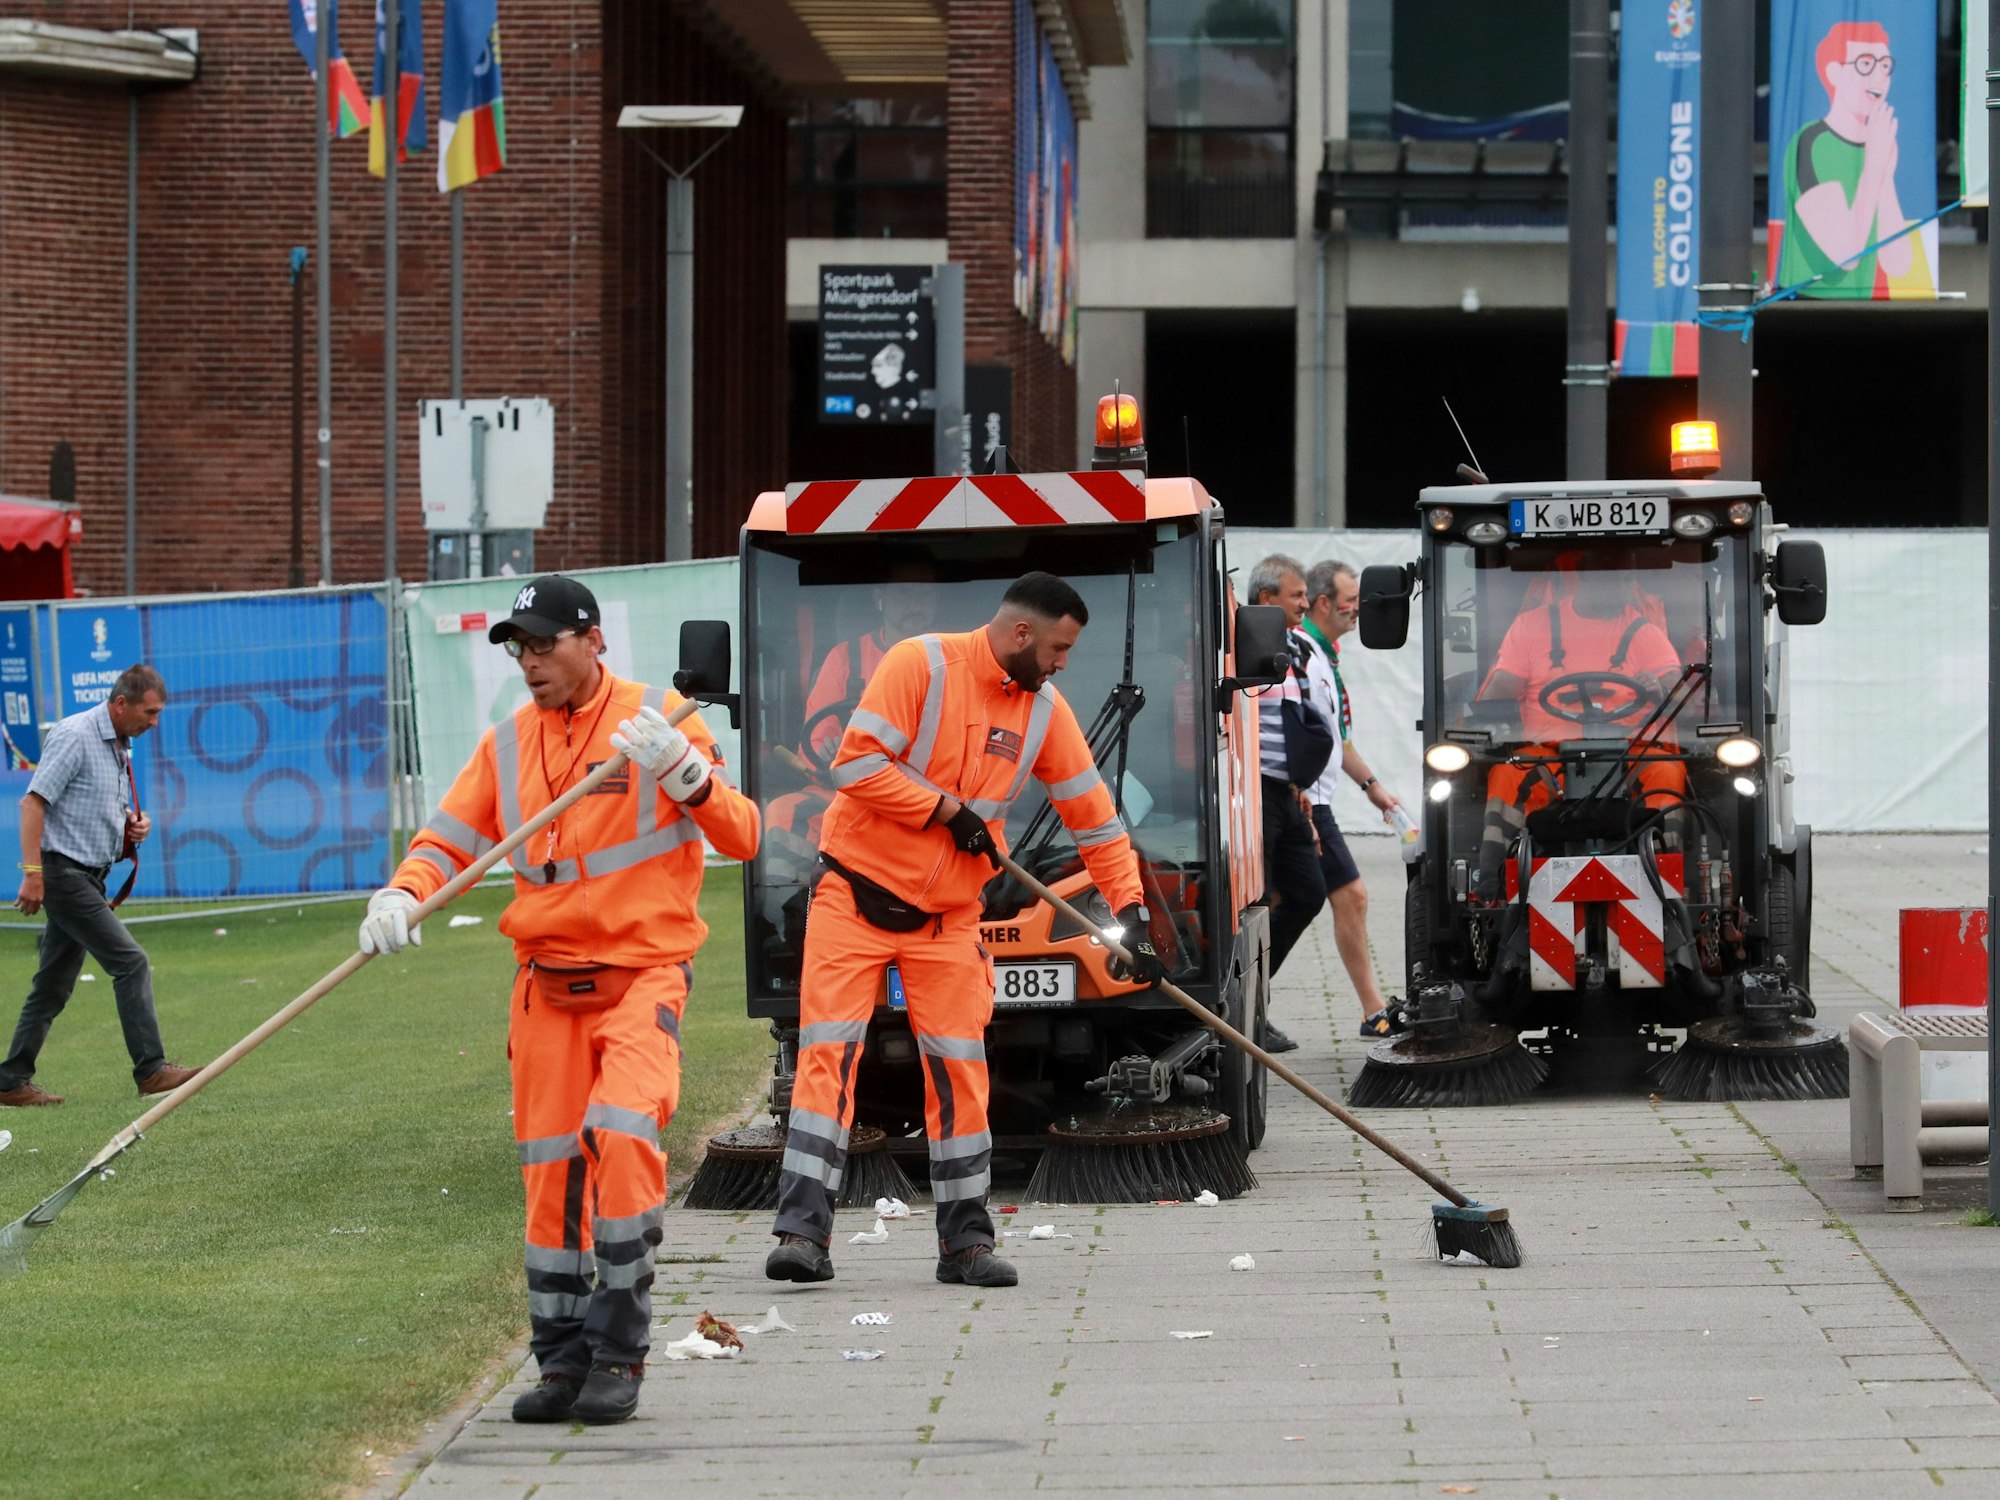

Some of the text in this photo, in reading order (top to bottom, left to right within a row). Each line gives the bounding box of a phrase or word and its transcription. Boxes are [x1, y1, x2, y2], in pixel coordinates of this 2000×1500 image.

[1669, 101, 1693, 287] COLOGNE
[1654, 177, 1667, 289] WELCOME TO
[824, 272, 895, 291] Sportpark
[825, 289, 918, 309] Müngersdorf
[1535, 504, 1551, 527] K
[1570, 503, 1603, 527] WB
[1609, 502, 1656, 526] 819
[72, 671, 97, 687] UEFA
[980, 927, 1022, 944] HER
[894, 969, 1060, 1000] D 883
